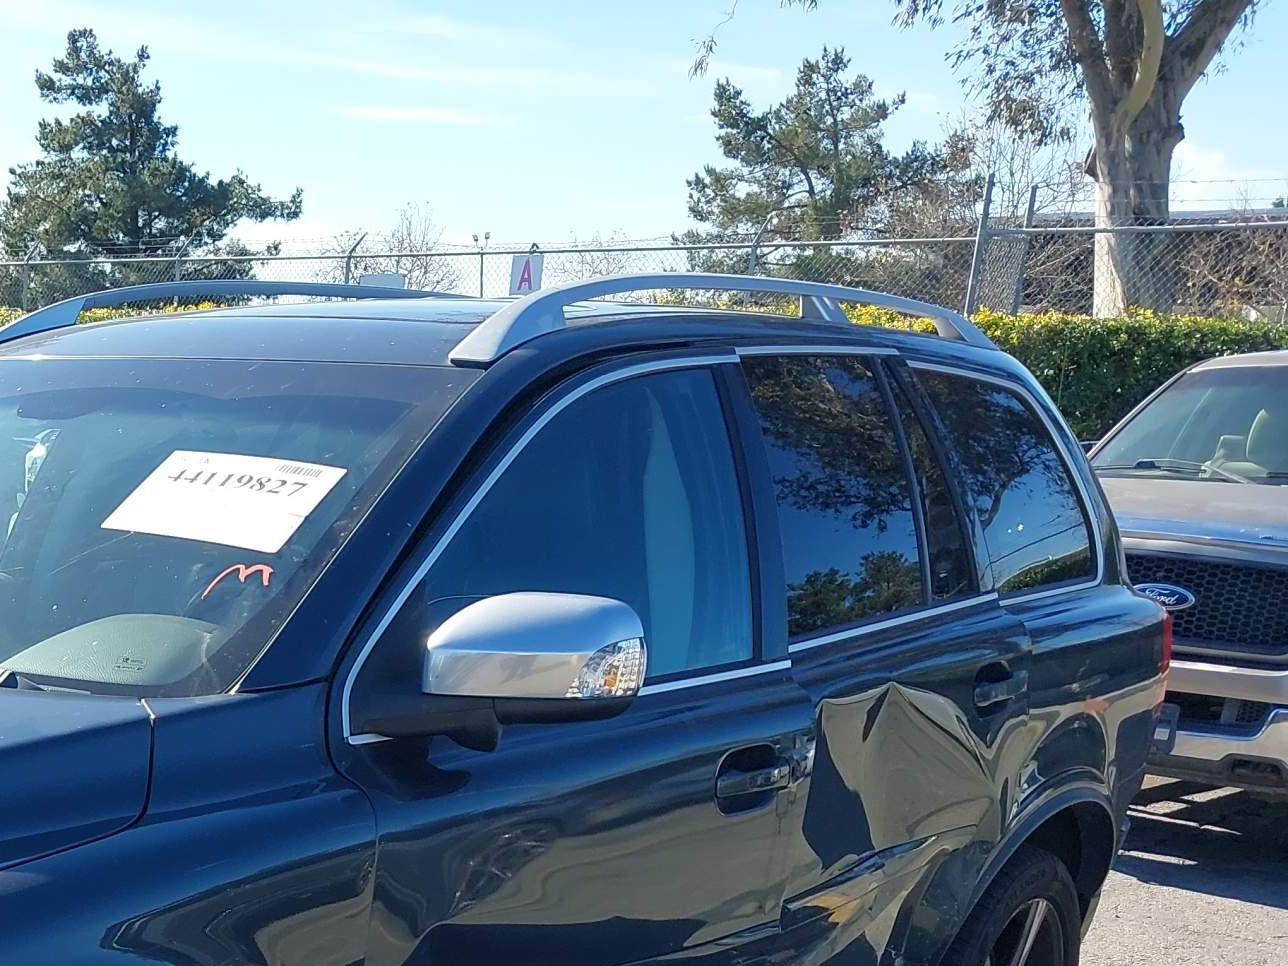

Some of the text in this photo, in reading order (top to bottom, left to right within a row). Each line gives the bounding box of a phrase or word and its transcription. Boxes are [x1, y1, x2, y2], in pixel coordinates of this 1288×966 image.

[517, 256, 533, 291] A
[168, 468, 309, 497] 44119827
[1144, 587, 1180, 605] Ford
